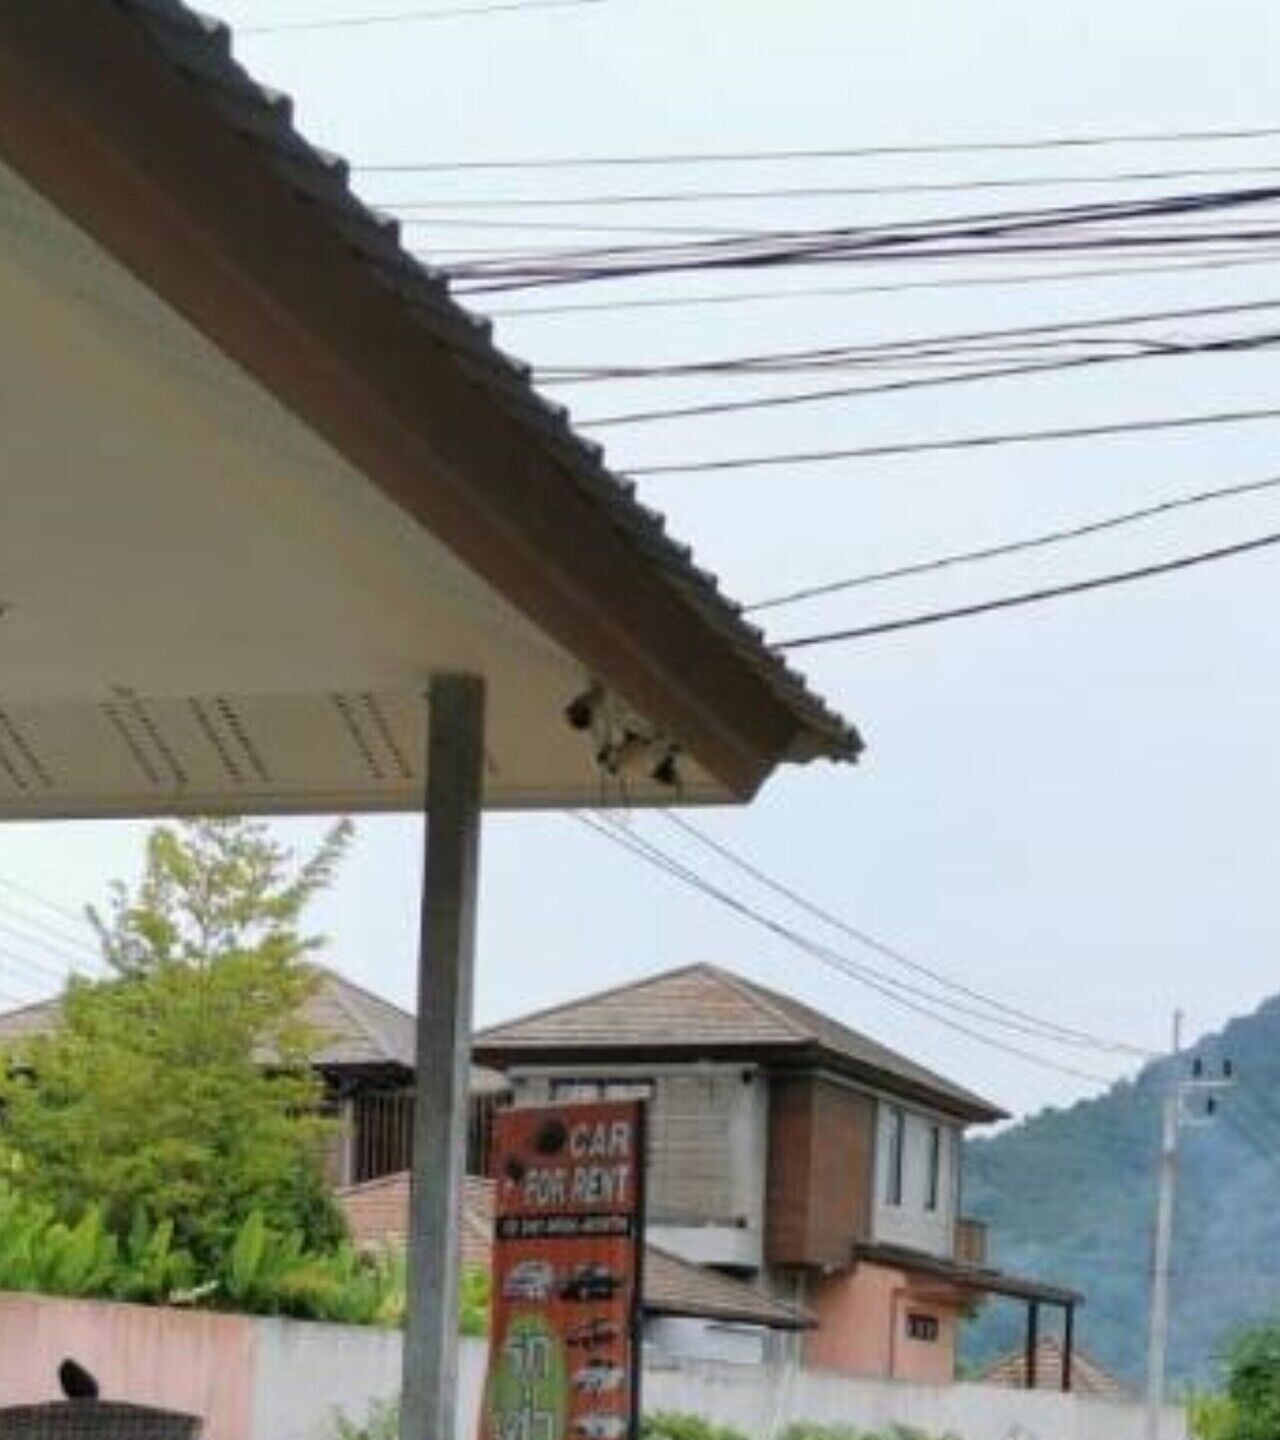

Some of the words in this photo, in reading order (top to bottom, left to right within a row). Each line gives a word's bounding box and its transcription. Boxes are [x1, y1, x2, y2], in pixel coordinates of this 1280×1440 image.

[570, 1121, 630, 1158] CAR
[524, 1167, 567, 1207] FOR
[574, 1162, 632, 1204] RENT
